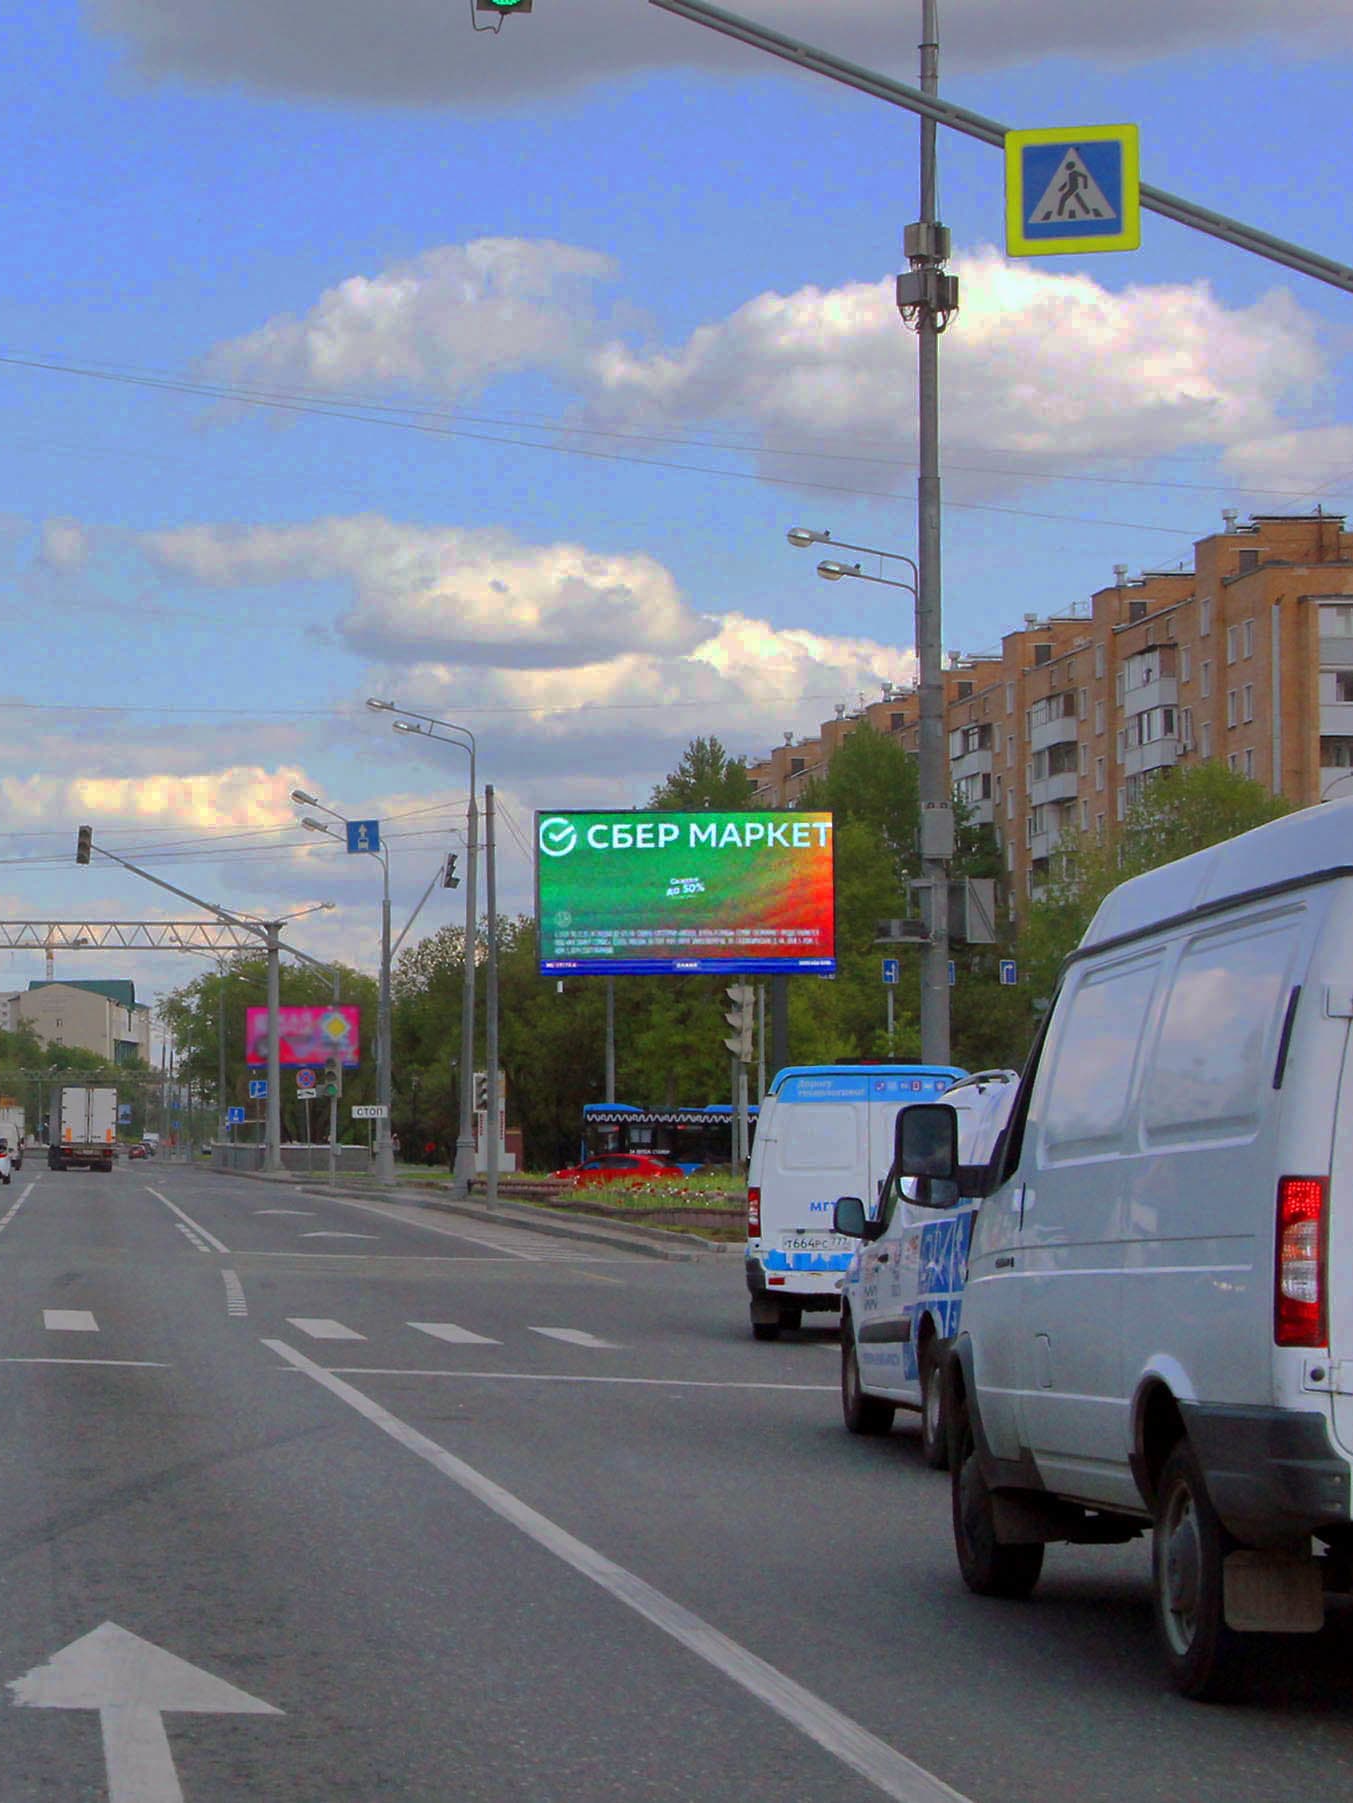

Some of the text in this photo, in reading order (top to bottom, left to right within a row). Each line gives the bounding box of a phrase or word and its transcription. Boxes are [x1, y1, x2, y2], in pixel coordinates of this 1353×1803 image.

[587, 821, 833, 849] СБЕР МАРКЕТ
[356, 1107, 383, 1116] СТОП
